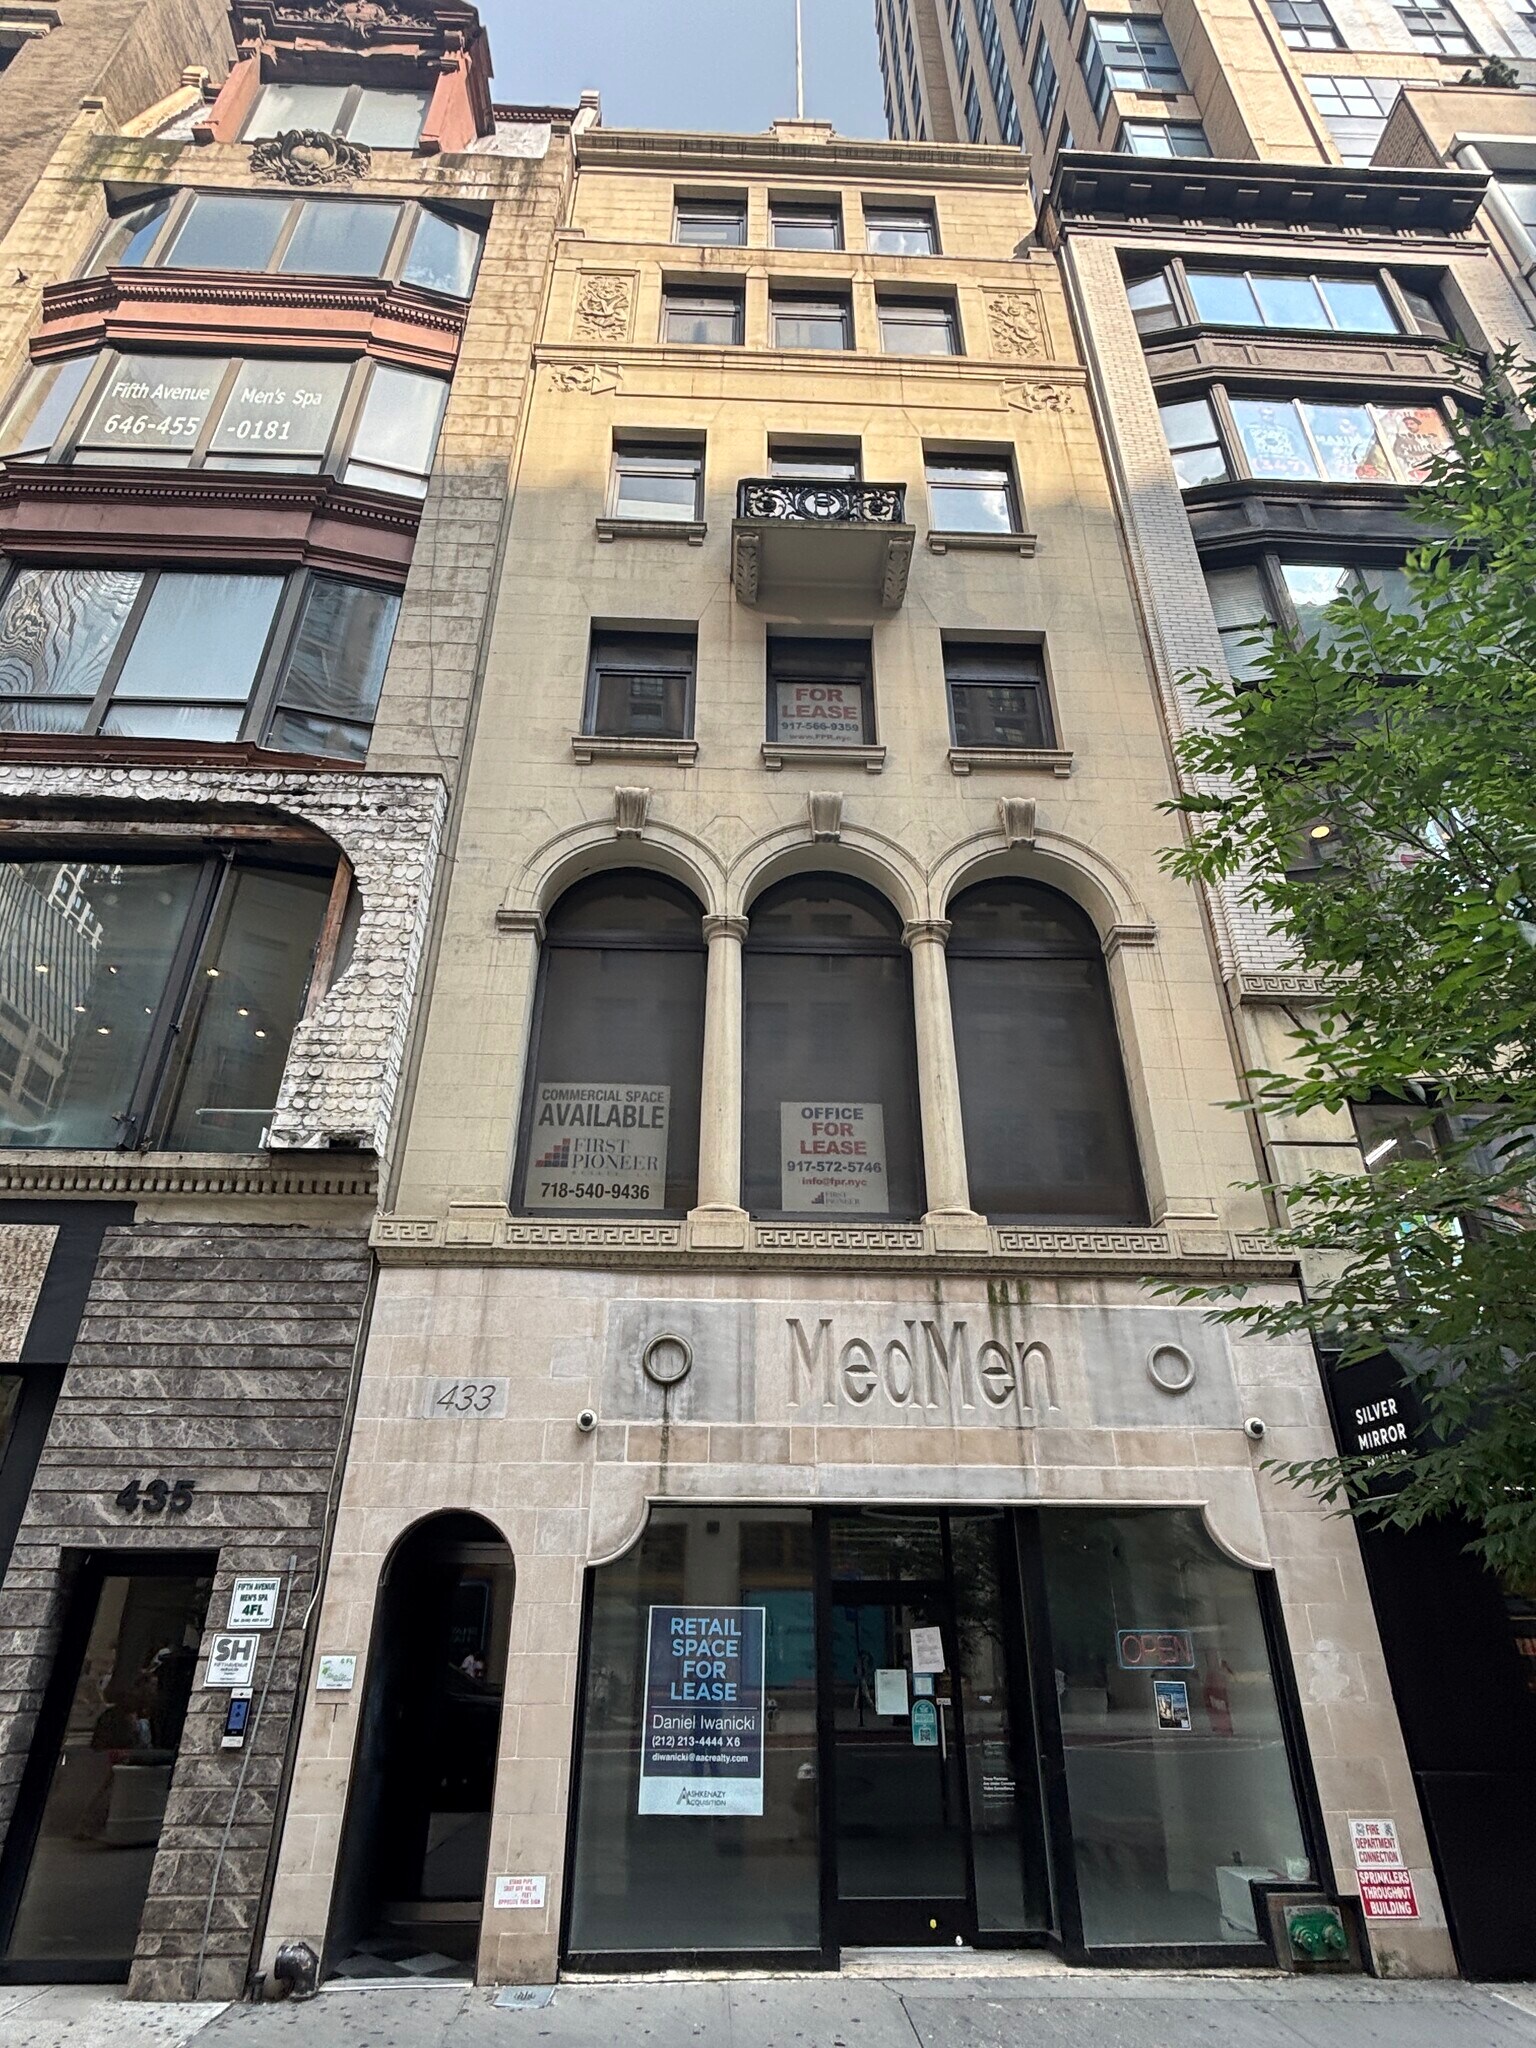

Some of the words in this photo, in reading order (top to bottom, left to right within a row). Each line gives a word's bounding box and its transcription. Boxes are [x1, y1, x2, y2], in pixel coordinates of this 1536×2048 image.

[112, 382, 149, 399] Fifth
[150, 383, 210, 401] Avenue
[241, 388, 286, 405] Men's
[292, 389, 323, 408] Spa
[104, 415, 200, 435] 646-455
[795, 687, 844, 702] FOR
[782, 704, 858, 720] LEASE
[541, 1088, 622, 1101] COMMERCIAL
[625, 1090, 665, 1103] SPACE
[538, 1103, 665, 1129] AVAILABLE
[800, 1107, 864, 1120] OFFICE
[811, 1122, 854, 1137] FOR
[573, 1137, 630, 1153] FIRST
[800, 1140, 867, 1155] LEASE
[571, 1153, 659, 1171] PIONEER
[787, 1160, 882, 1173] 917-572-5746
[801, 1176, 868, 1188] info@fpr.nyc
[541, 1182, 650, 1200] 718-540-9436
[785, 1318, 1061, 1411] MedMen
[436, 1384, 496, 1411] 433
[1355, 1398, 1398, 1425] SILVER
[1358, 1423, 1407, 1451] MIRROR
[116, 1479, 196, 1514] 435
[237, 1583, 253, 1591] FIFTH
[254, 1583, 276, 1591] AVENUE
[241, 1604, 264, 1616] 4FL
[670, 1617, 742, 1636] RETAIL
[214, 1638, 252, 1661] SH
[671, 1638, 739, 1658] SPACE
[1122, 1634, 1191, 1663] OPEN
[683, 1660, 727, 1679] FOR
[670, 1682, 737, 1701] LEASE
[652, 1714, 696, 1729] Daniel
[700, 1715, 755, 1730] Iwanicki
[652, 1736, 675, 1748] (212)
[677, 1736, 723, 1747] 213-4444
[652, 1753, 749, 1764] diwanicki@aacrealty.com
[1365, 1824, 1380, 1835] FIRE
[1355, 1837, 1396, 1849] DEPARTMENT
[1359, 1851, 1399, 1862] CONNECTION
[1359, 1871, 1410, 1885] SPRINKLERS
[1362, 1886, 1412, 1900] THROUGHOUT
[1369, 1901, 1413, 1915] BUILDING
